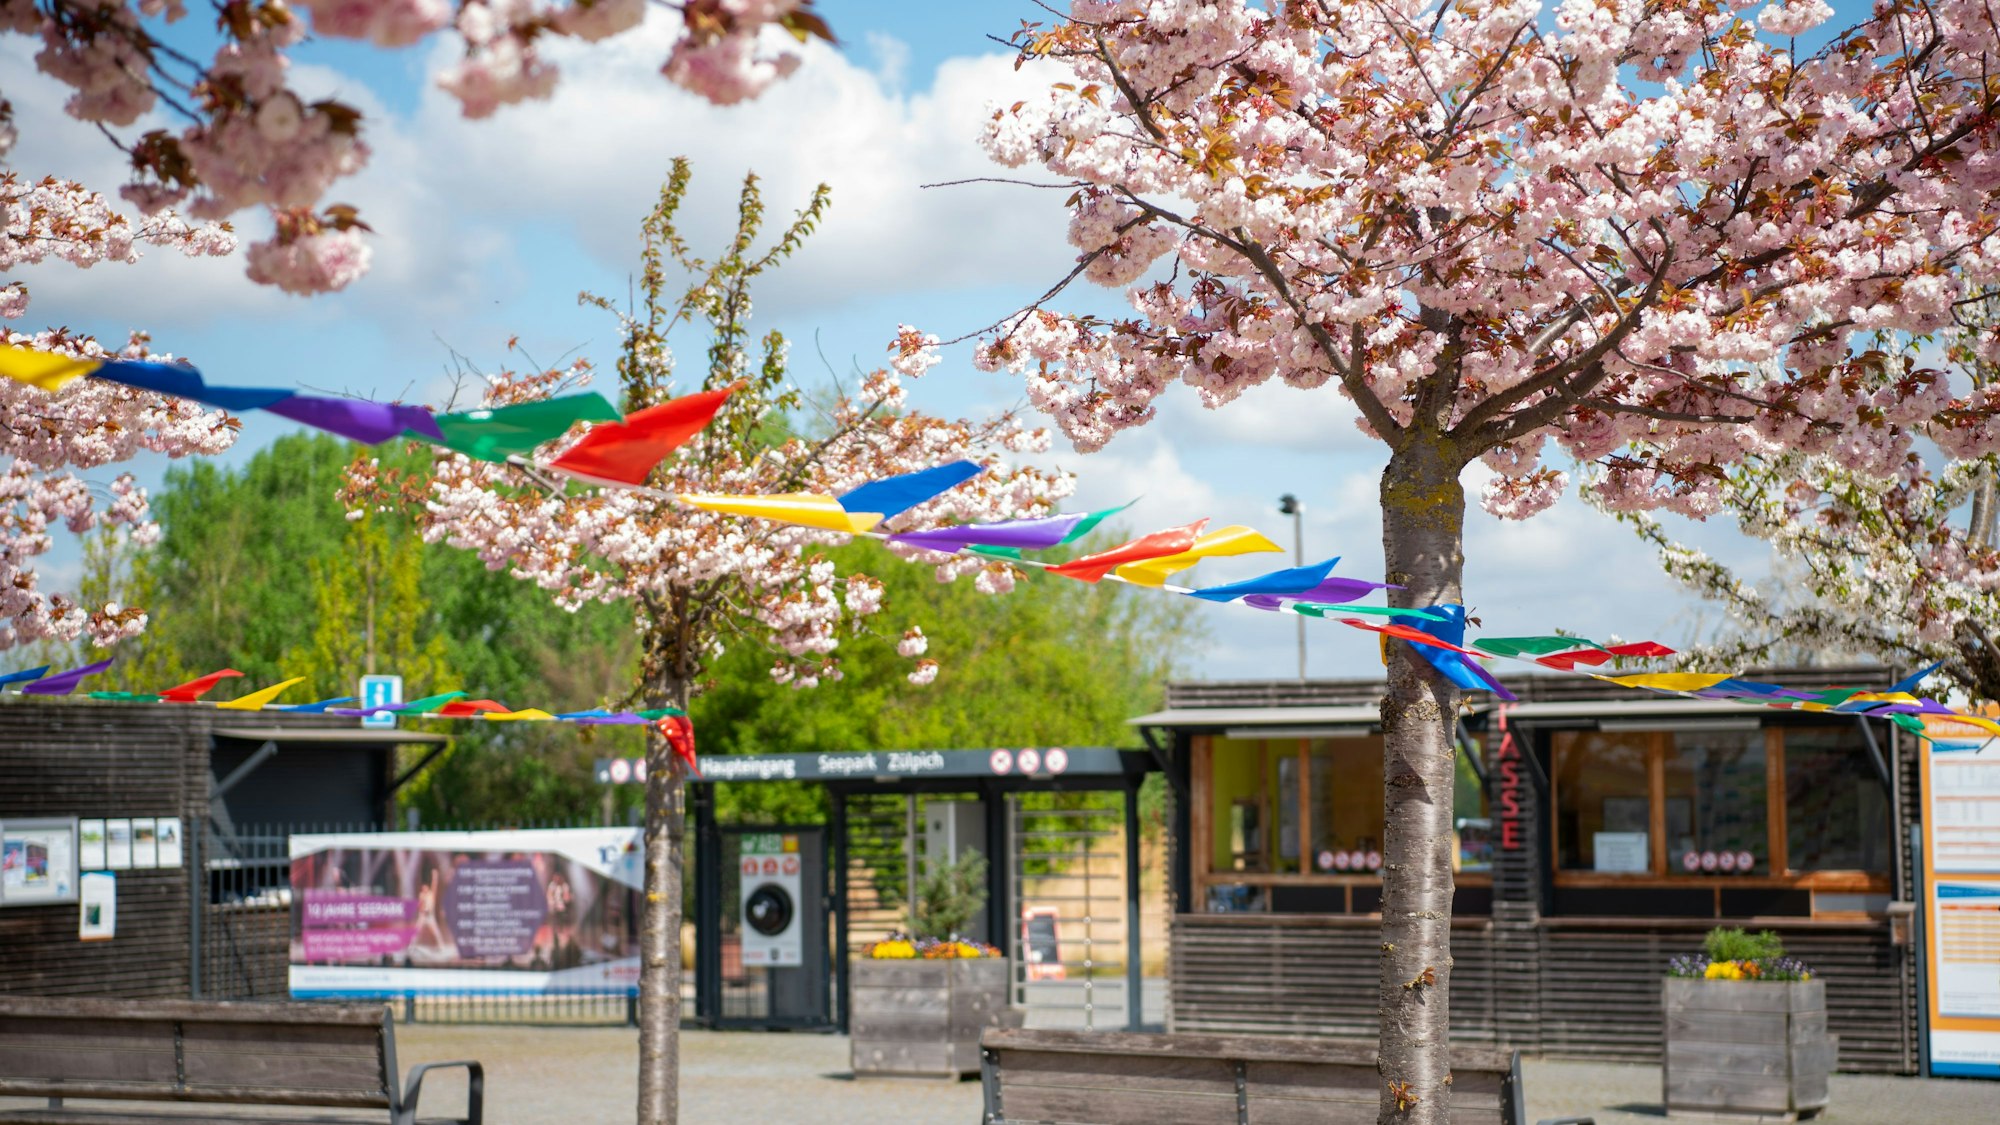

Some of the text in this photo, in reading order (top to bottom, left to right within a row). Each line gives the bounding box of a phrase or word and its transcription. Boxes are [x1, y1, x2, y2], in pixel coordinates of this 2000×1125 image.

[700, 751, 944, 779] Haupteingang Seepark Zülpich
